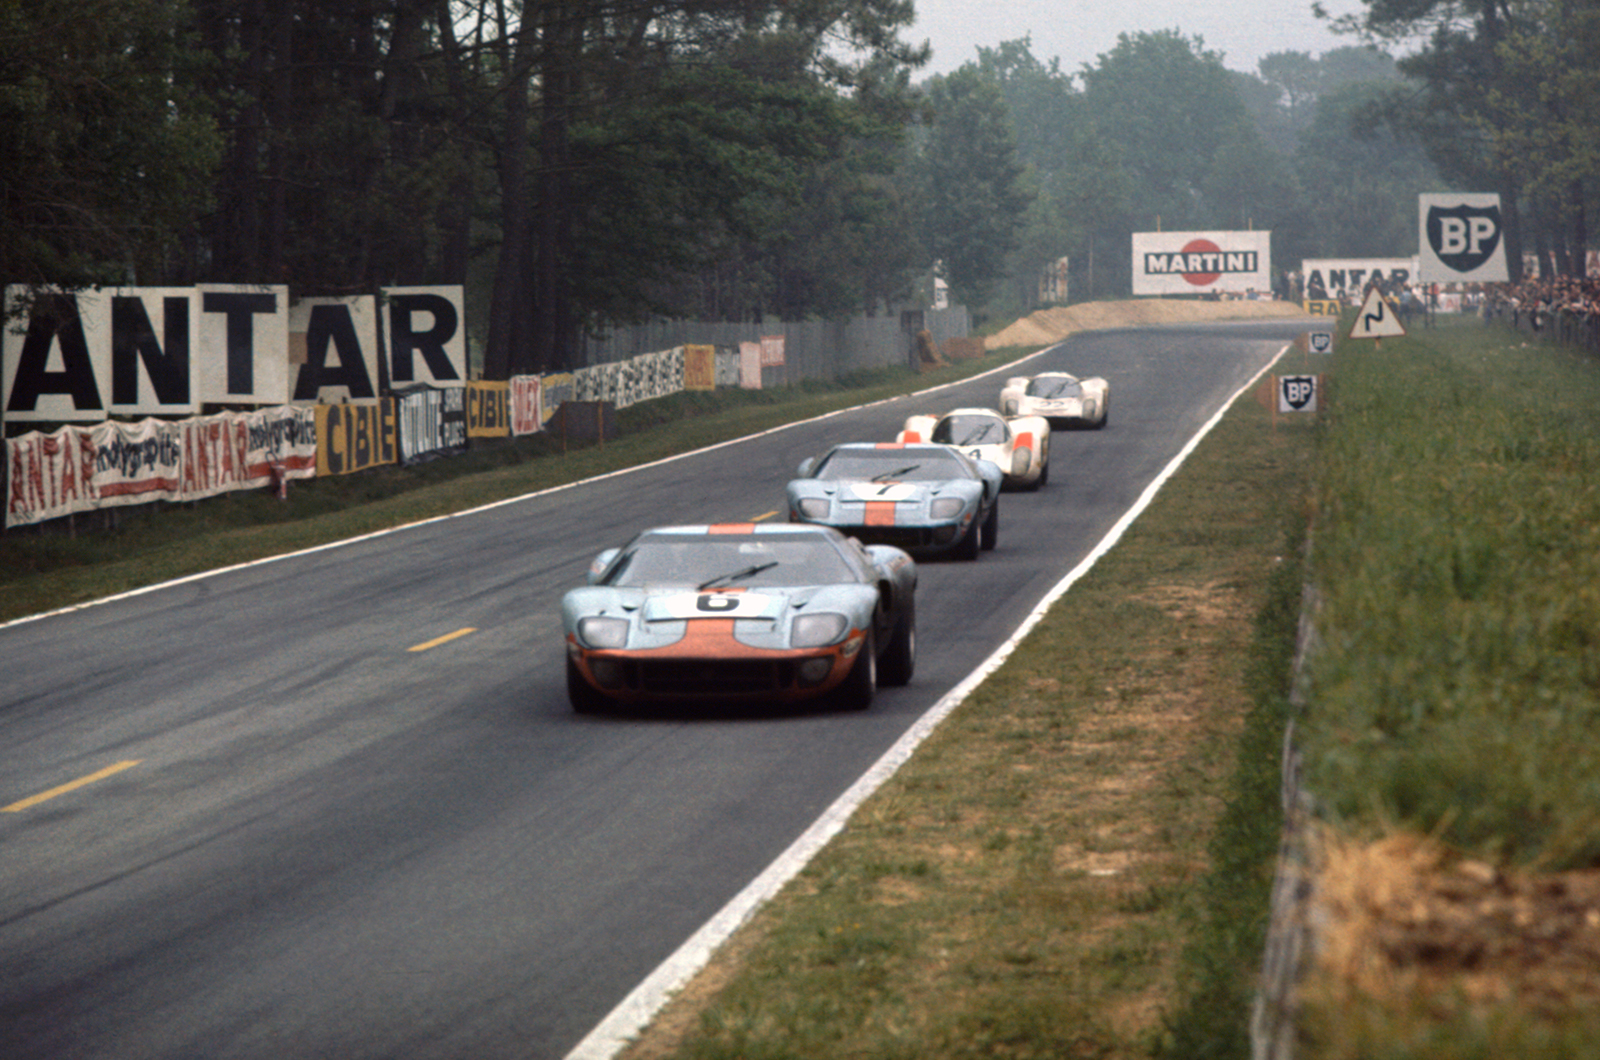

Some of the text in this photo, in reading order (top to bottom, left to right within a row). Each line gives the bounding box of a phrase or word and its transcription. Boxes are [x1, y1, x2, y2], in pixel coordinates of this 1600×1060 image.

[1438, 216, 1496, 255] BP
[1147, 252, 1255, 273] MARTINI
[1307, 268, 1409, 290] ANTAR
[6, 291, 461, 412] ANTAR
[1287, 382, 1311, 402] BP
[327, 398, 394, 474] CIBIE
[10, 432, 97, 513] ANTAR
[183, 418, 249, 493] ANTAR
